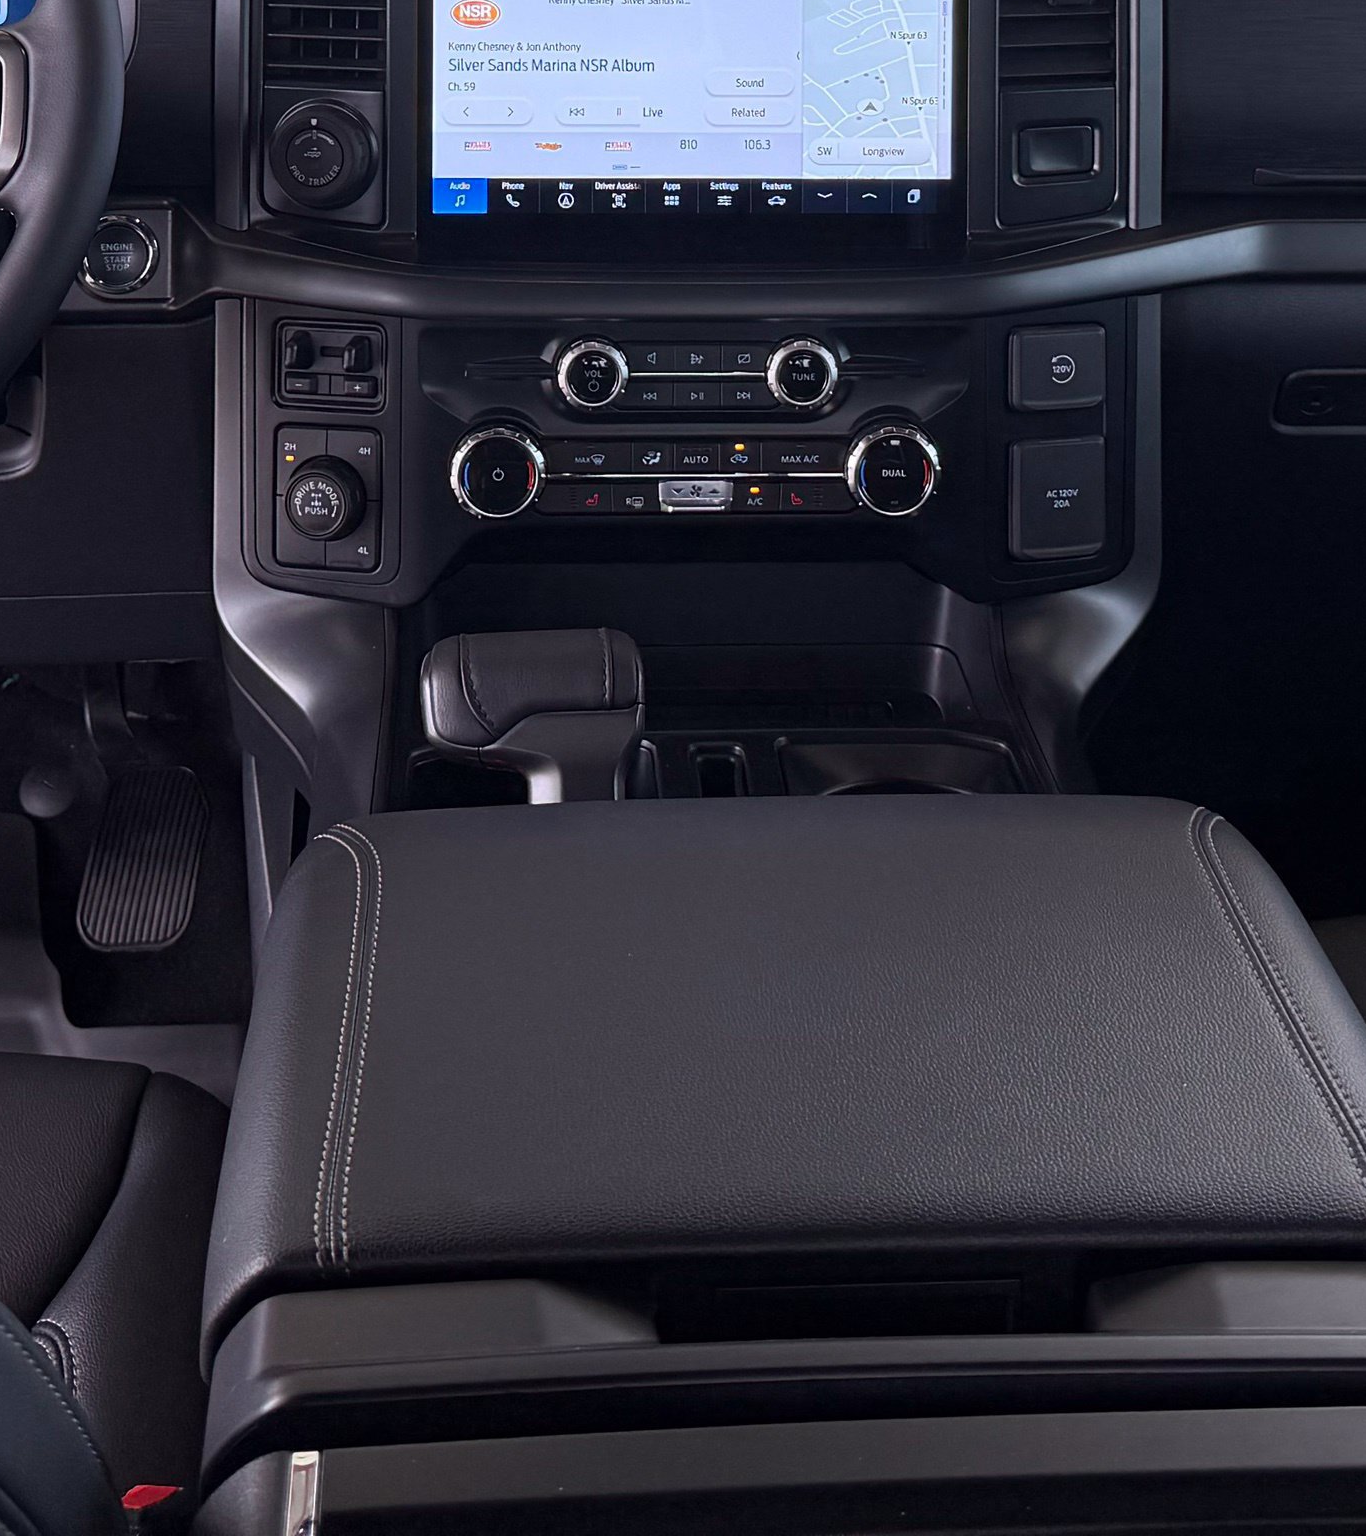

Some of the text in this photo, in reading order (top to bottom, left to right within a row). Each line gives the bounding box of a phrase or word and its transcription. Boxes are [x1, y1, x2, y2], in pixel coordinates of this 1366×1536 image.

[458, 4, 492, 18] NSR
[890, 31, 928, 41] N Spur 63
[448, 42, 582, 53] Kenny Chesney & Jon Anthony
[448, 59, 656, 72] Silver Sands Marina NSR Album
[448, 82, 476, 92] Ch. 59
[735, 79, 765, 88] Sound
[901, 97, 908, 105] N
[908, 97, 928, 107] Spur
[642, 107, 664, 118] Live
[731, 108, 766, 118] Related
[679, 139, 698, 151] 810
[744, 139, 771, 150] 106.3
[817, 146, 905, 158] SW Longview
[289, 164, 341, 187] PRO TRAILER
[449, 181, 471, 191] Audio
[501, 181, 525, 191] Phone
[558, 181, 574, 191] Nav
[594, 181, 615, 191] Driver
[662, 181, 681, 193] Apps
[709, 182, 740, 193] Settings
[761, 182, 793, 191] Features
[100, 242, 134, 252] ENGINE
[103, 255, 132, 264] START
[105, 263, 130, 272] STOP
[584, 370, 603, 378] VOL
[1052, 365, 1072, 374] 120V
[792, 373, 816, 381] TUNE
[284, 442, 297, 452] 2H
[358, 447, 371, 456] 4H
[574, 455, 591, 464] MAX
[683, 455, 709, 465] AUTO
[780, 455, 820, 464] MAX A/C
[881, 468, 907, 478] DUAL
[294, 481, 340, 507] DRIVE MODE
[1046, 488, 1079, 498] AC 120V
[747, 497, 764, 506] A/C
[1053, 499, 1071, 509] 20A
[304, 506, 329, 516] PUSH
[357, 546, 369, 555] 4L
